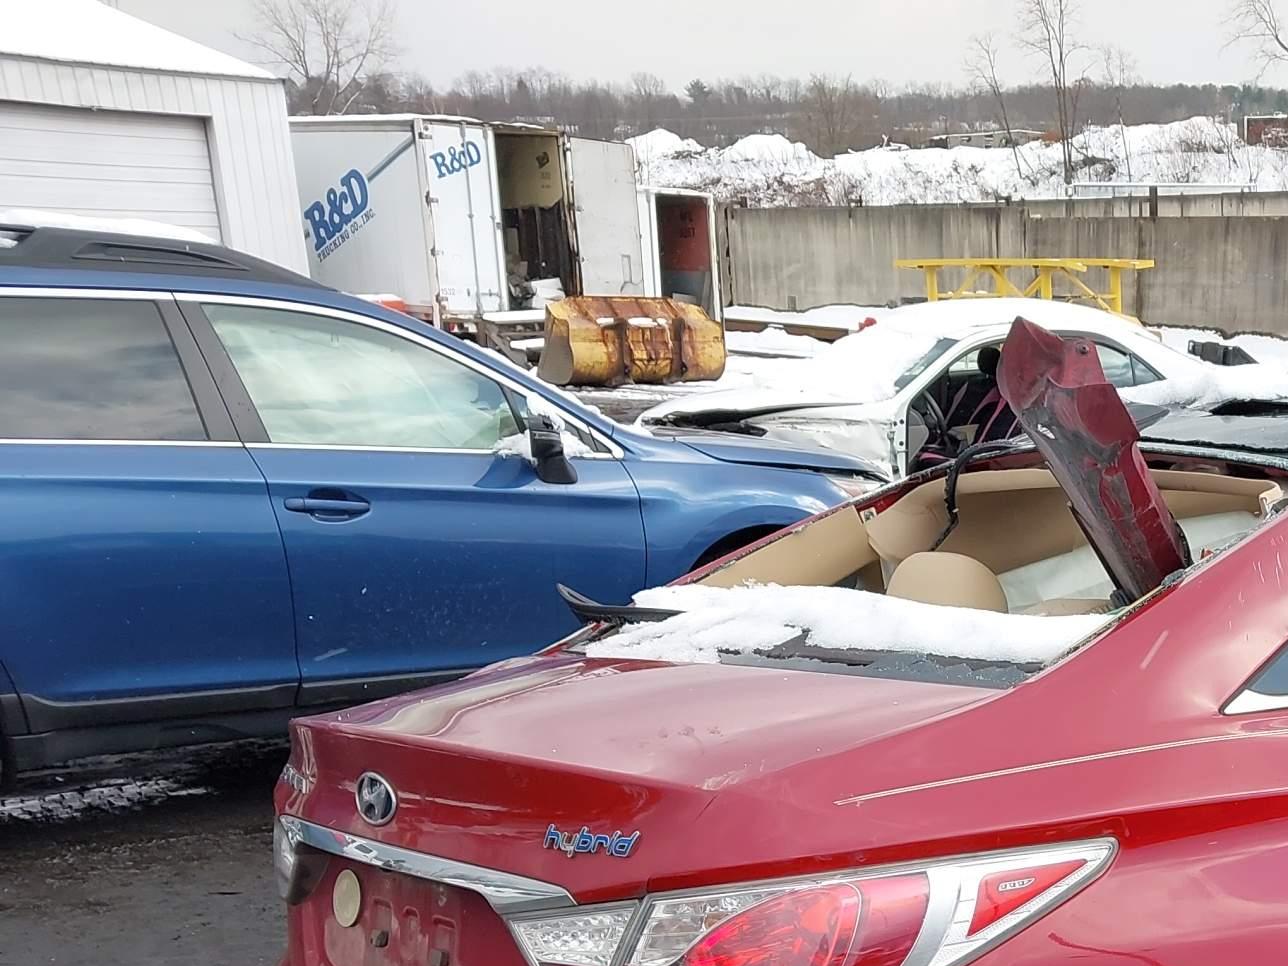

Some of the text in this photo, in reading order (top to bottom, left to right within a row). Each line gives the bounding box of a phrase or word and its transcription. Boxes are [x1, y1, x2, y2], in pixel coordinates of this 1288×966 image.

[429, 141, 481, 179] R&D
[304, 169, 368, 252] R&D
[317, 229, 350, 263] TRUCKING
[543, 823, 640, 858] hybrid
